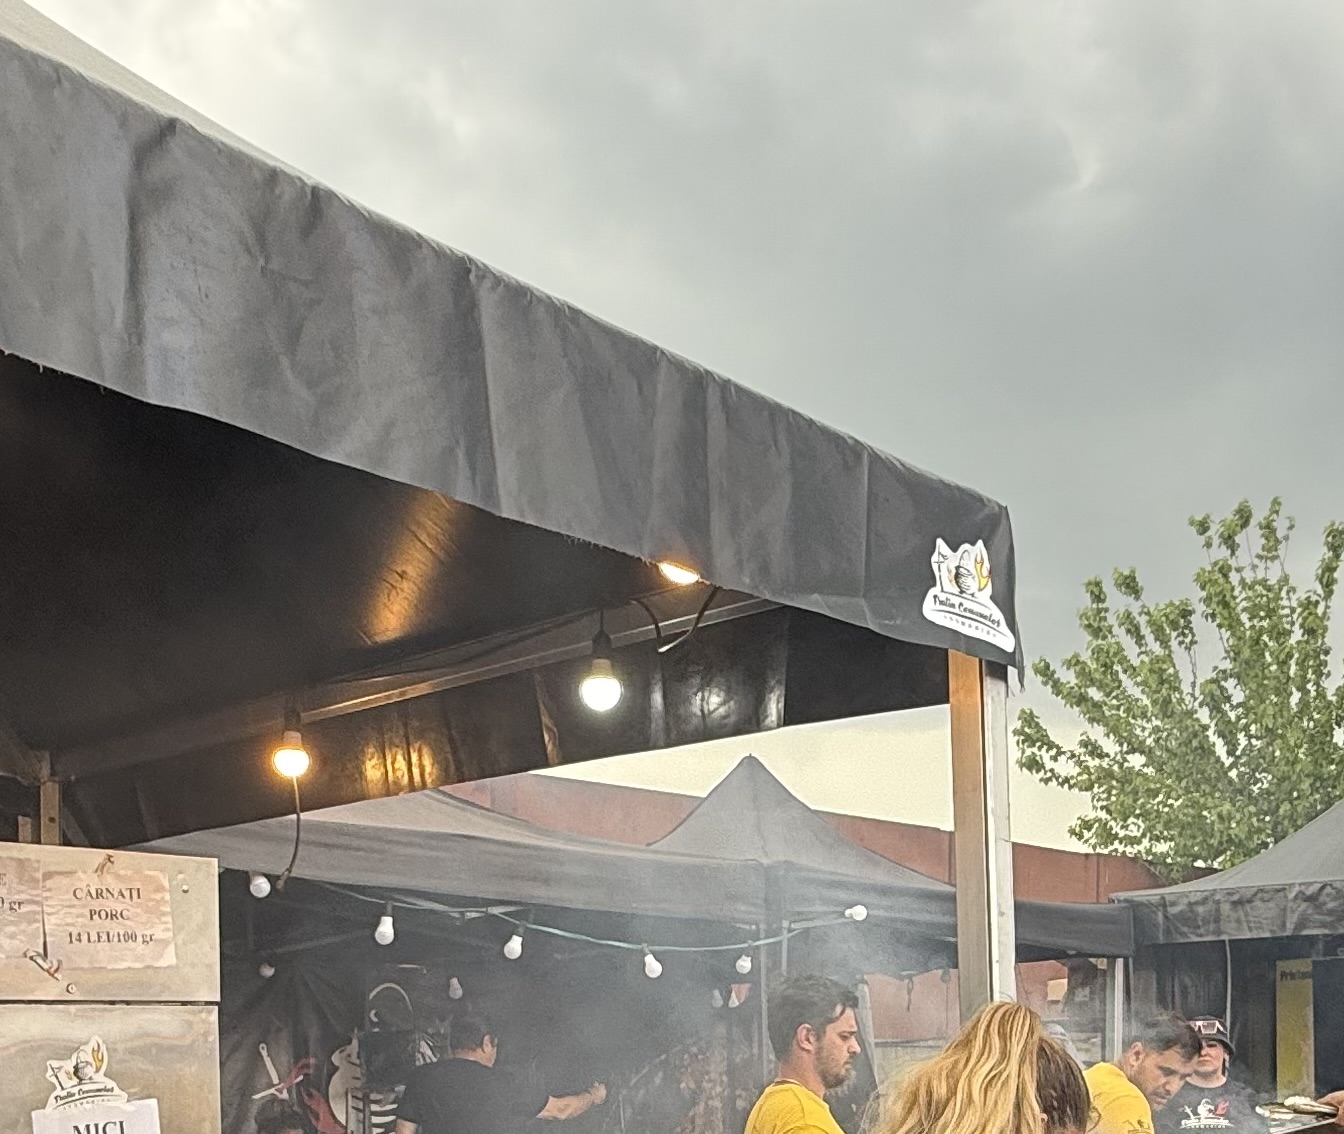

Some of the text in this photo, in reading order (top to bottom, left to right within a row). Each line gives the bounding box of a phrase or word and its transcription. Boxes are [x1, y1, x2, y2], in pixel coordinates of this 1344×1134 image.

[9, 899, 25, 912] gr
[89, 908, 131, 922] PORC
[68, 930, 155, 948] 14 LEI/100 gr
